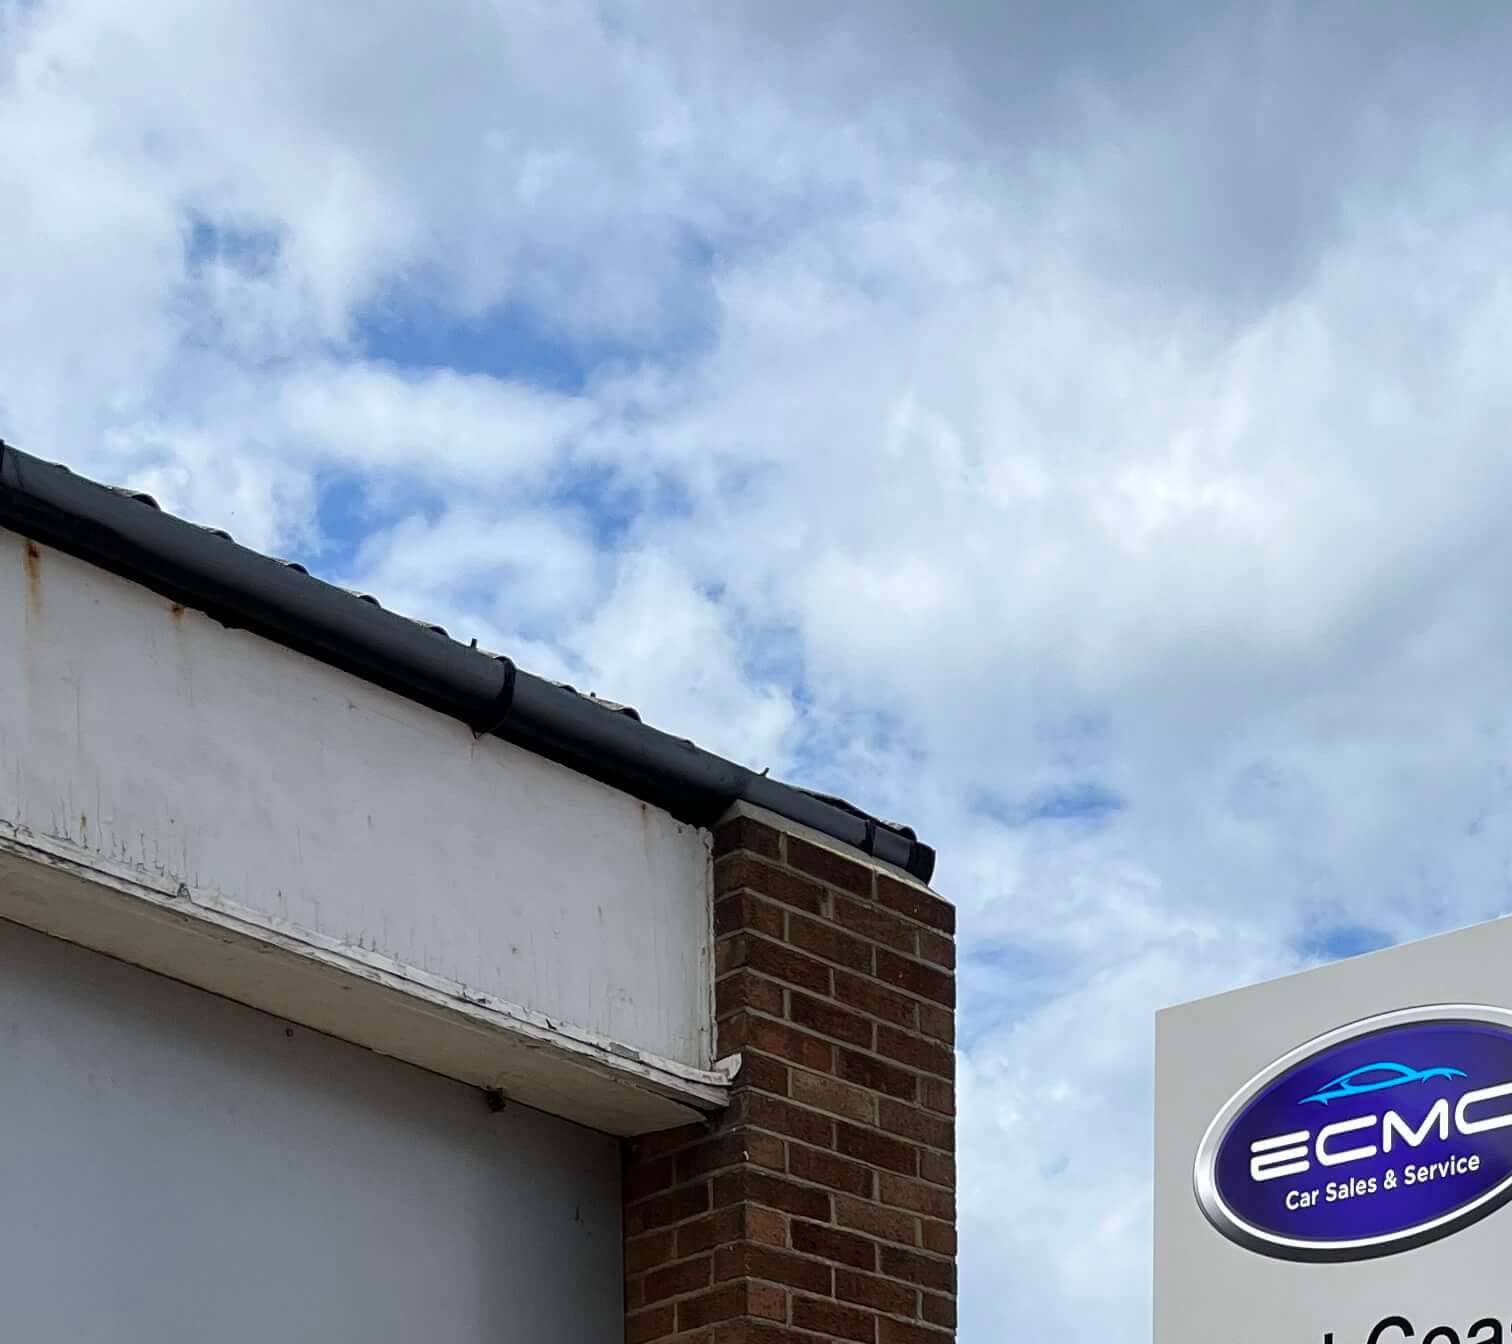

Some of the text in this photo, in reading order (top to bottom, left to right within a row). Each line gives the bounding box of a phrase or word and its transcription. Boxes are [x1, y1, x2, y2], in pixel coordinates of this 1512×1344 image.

[1285, 1152, 1481, 1210] Car Sales & Service
